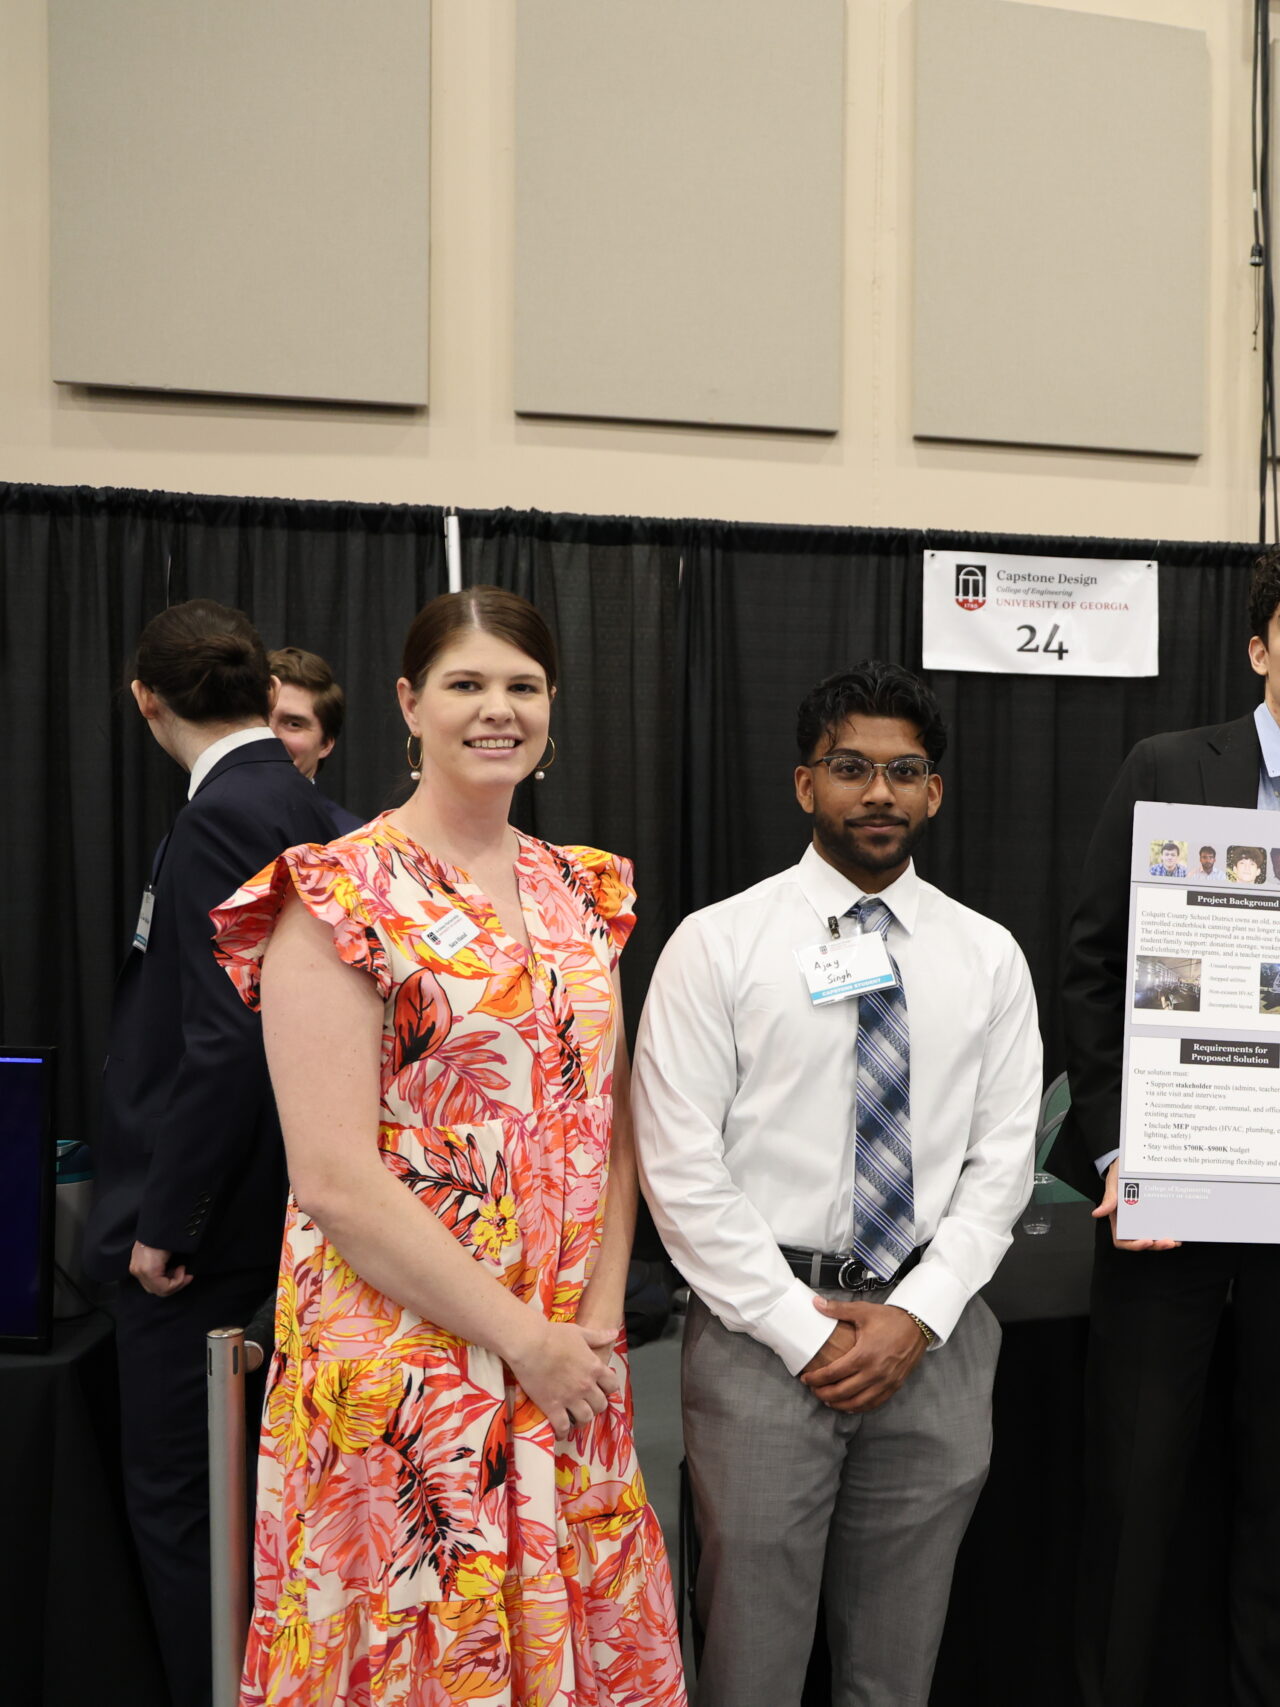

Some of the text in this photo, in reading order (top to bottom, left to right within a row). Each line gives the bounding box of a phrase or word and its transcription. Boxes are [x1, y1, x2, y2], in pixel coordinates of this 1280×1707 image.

[997, 570, 1098, 588] Capstone Design
[996, 586, 1073, 598] College of Engineering
[996, 598, 1129, 611] UNIVERSITY OF GEORGIA
[1016, 624, 1069, 660] 24
[1197, 895, 1279, 908] Project Background
[1141, 911, 1166, 919] Colquitt
[1167, 912, 1188, 921] County
[814, 960, 839, 971] Ajay
[827, 969, 852, 984] Singh
[1193, 1044, 1253, 1053] Requirements
[1191, 1054, 1269, 1064] Proposed Solution
[1150, 1081, 1174, 1089] Support
[1232, 1085, 1257, 1093] (admins,
[1150, 1102, 1193, 1110] Accommodate
[1194, 1104, 1217, 1112] storage,
[1144, 1111, 1168, 1119] existing
[1191, 1125, 1218, 1133] upgrades
[1219, 1126, 1244, 1134] (HVAC,
[1245, 1127, 1275, 1136] plumbing,
[1170, 1133, 1191, 1141] safety)
[1147, 1143, 1161, 1152] Stay
[1229, 1146, 1250, 1155] budget
[1201, 1158, 1235, 1166] prioritizing
[1236, 1158, 1265, 1167] flexibility
